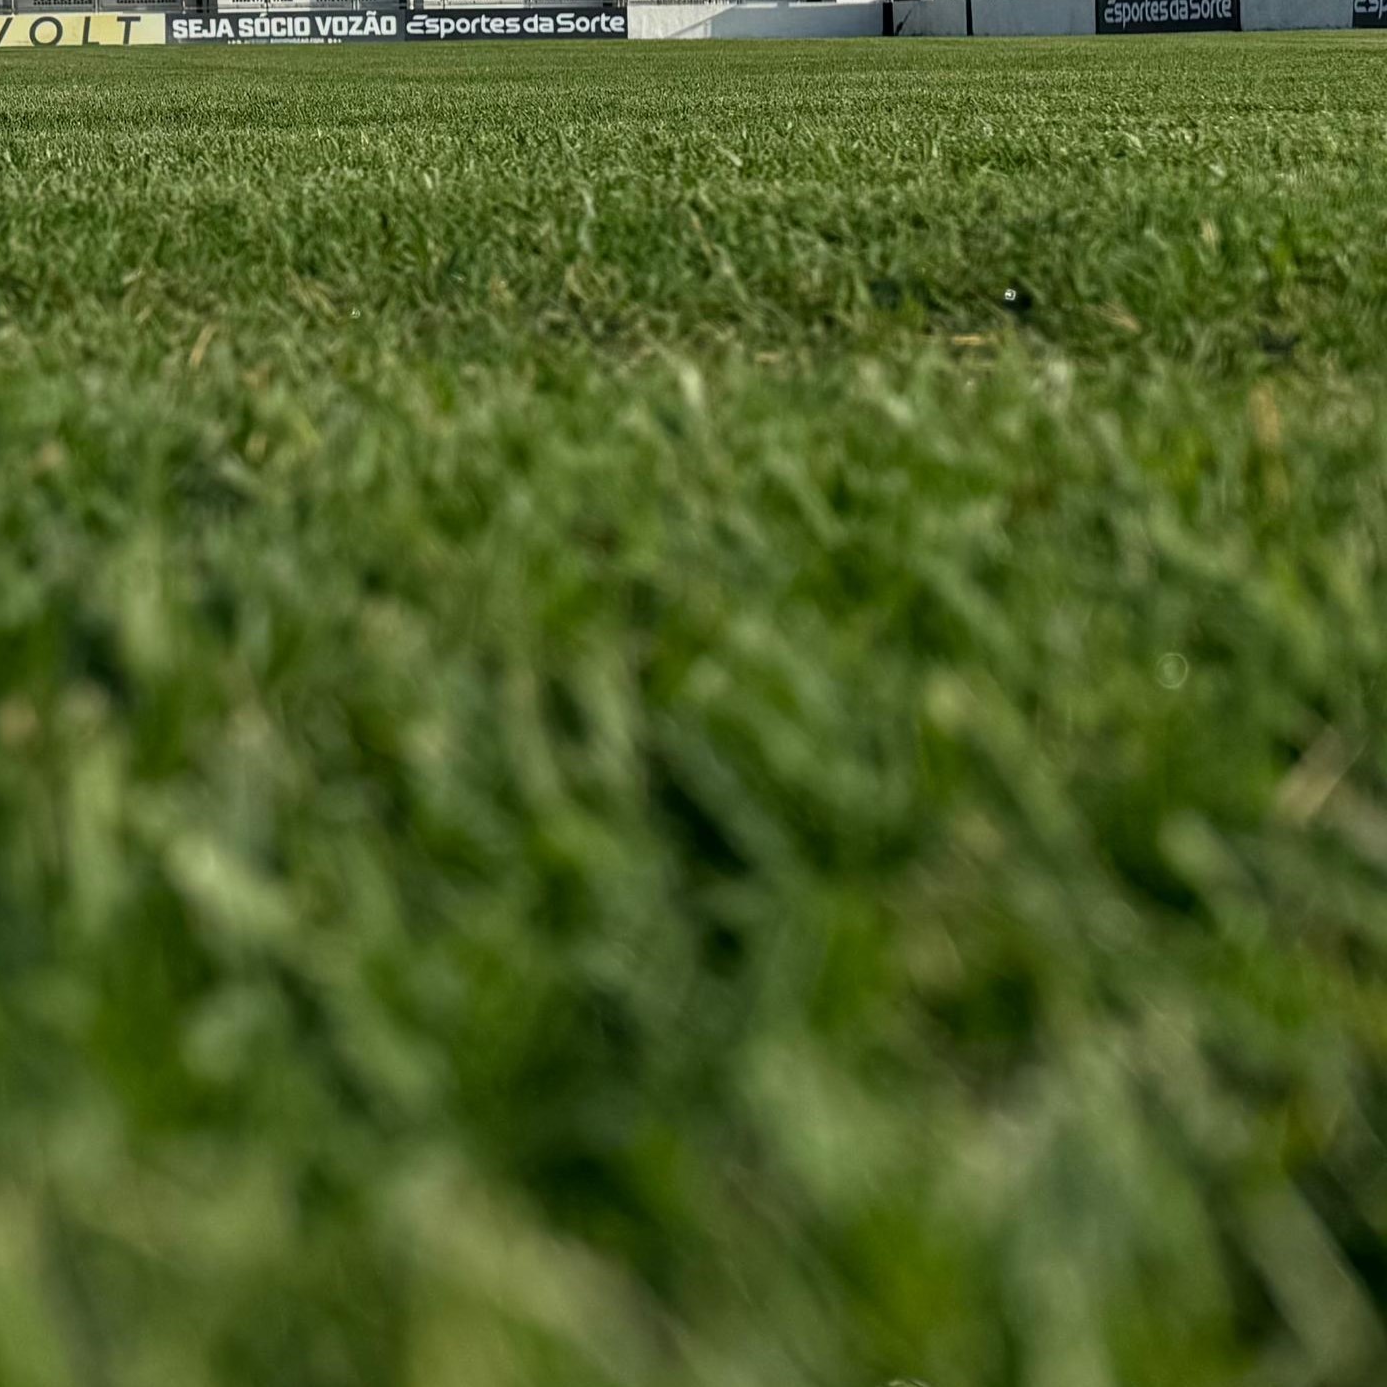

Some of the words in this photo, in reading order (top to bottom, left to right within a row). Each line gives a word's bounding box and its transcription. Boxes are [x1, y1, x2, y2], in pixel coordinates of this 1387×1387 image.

[172, 18, 234, 38] SEJA
[238, 13, 311, 37] SÓCIO
[315, 10, 397, 36] VOZÃO
[406, 14, 520, 38] Esportes
[556, 12, 625, 33] Sorte
